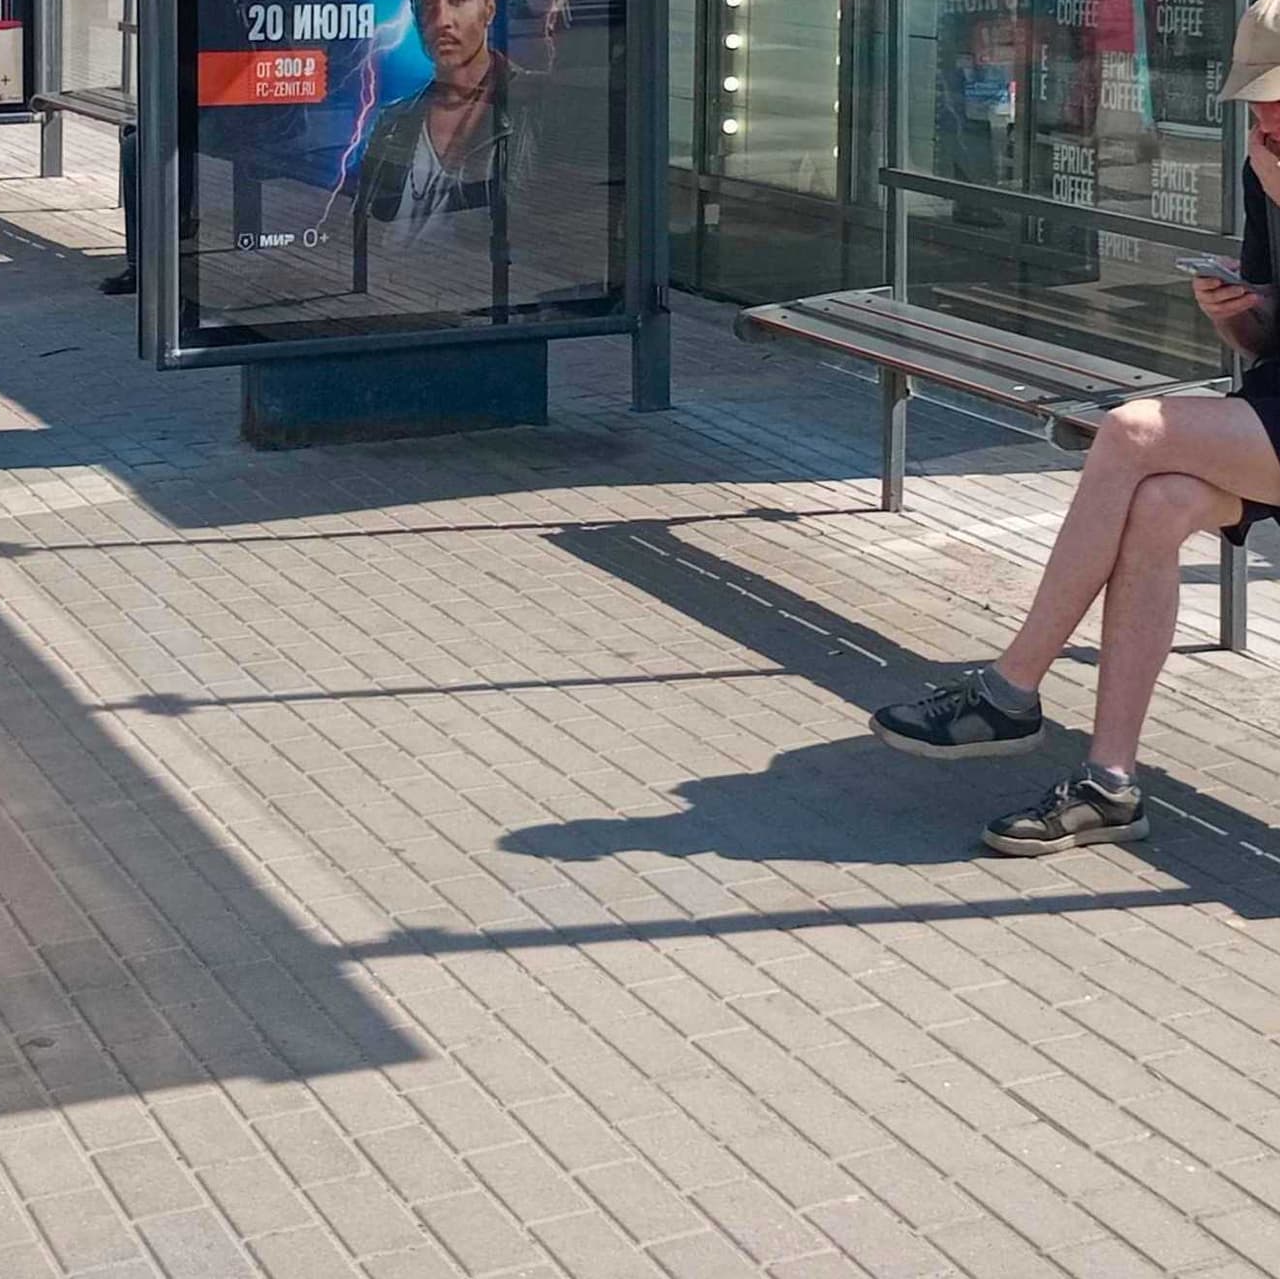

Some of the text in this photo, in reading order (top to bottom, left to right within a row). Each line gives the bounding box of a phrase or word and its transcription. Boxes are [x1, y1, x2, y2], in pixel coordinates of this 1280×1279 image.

[248, 3, 375, 41] 20 ИЮЛЯ
[256, 63, 272, 79] ОТ
[275, 58, 302, 78] 300
[256, 81, 316, 97] FC-ZENIT.RU
[1101, 81, 1145, 113] COFFEE
[1060, 144, 1095, 177] PRICE
[1052, 174, 1095, 207] COFFEE
[1160, 160, 1199, 194] PRICE
[1151, 191, 1198, 226] COFFEE
[259, 234, 295, 247] МИР
[303, 228, 329, 248] 0+
